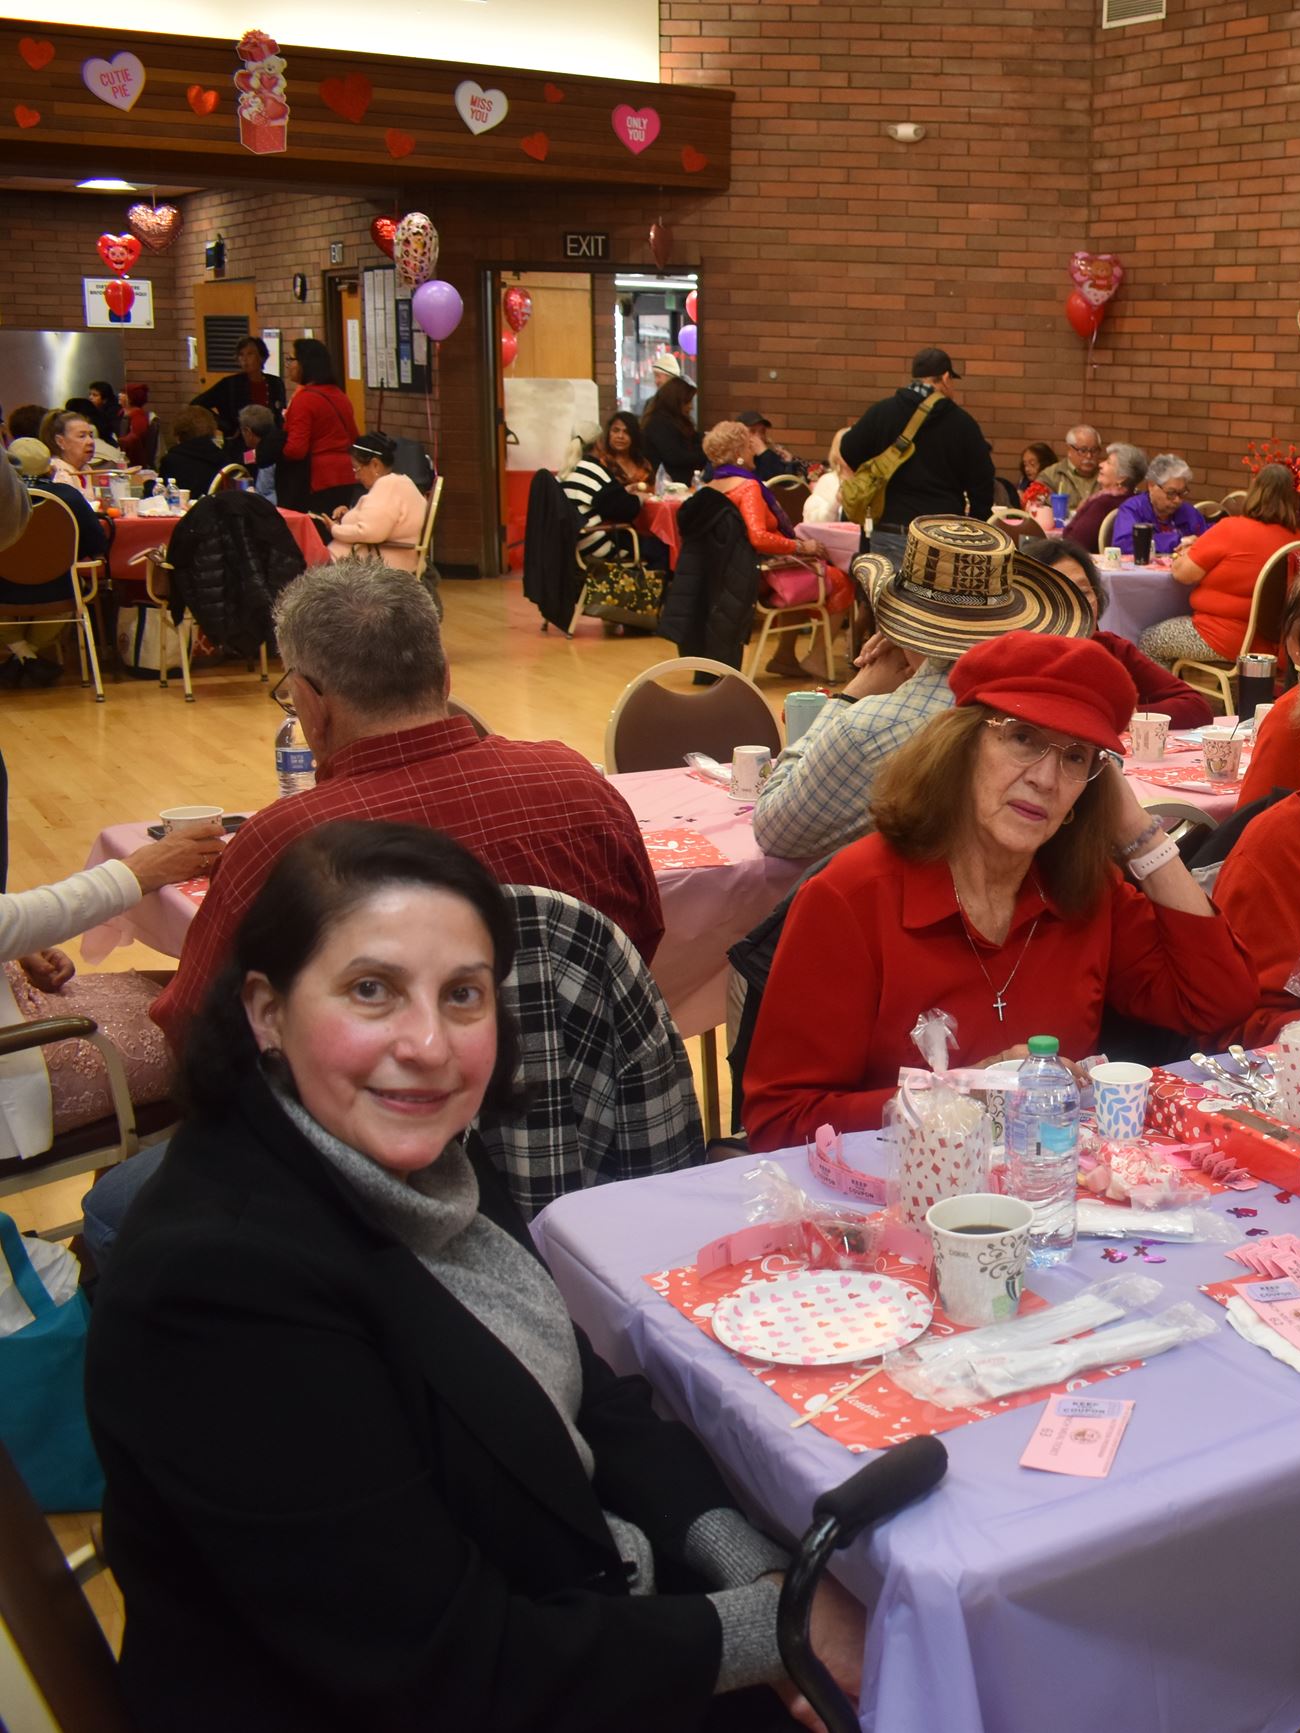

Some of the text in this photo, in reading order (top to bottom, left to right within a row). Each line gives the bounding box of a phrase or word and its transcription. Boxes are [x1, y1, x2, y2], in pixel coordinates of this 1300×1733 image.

[99, 68, 133, 87] CUTIE
[111, 84, 130, 99] PIE
[470, 94, 494, 112] MISS
[470, 107, 489, 123] YOU
[626, 115, 649, 130] ONLY
[627, 127, 646, 142] YOU
[566, 234, 606, 257] EXIT
[851, 1179, 868, 1188] KEEP
[849, 1186, 875, 1198] COUPON
[1063, 1407, 1106, 1415] COUPON
